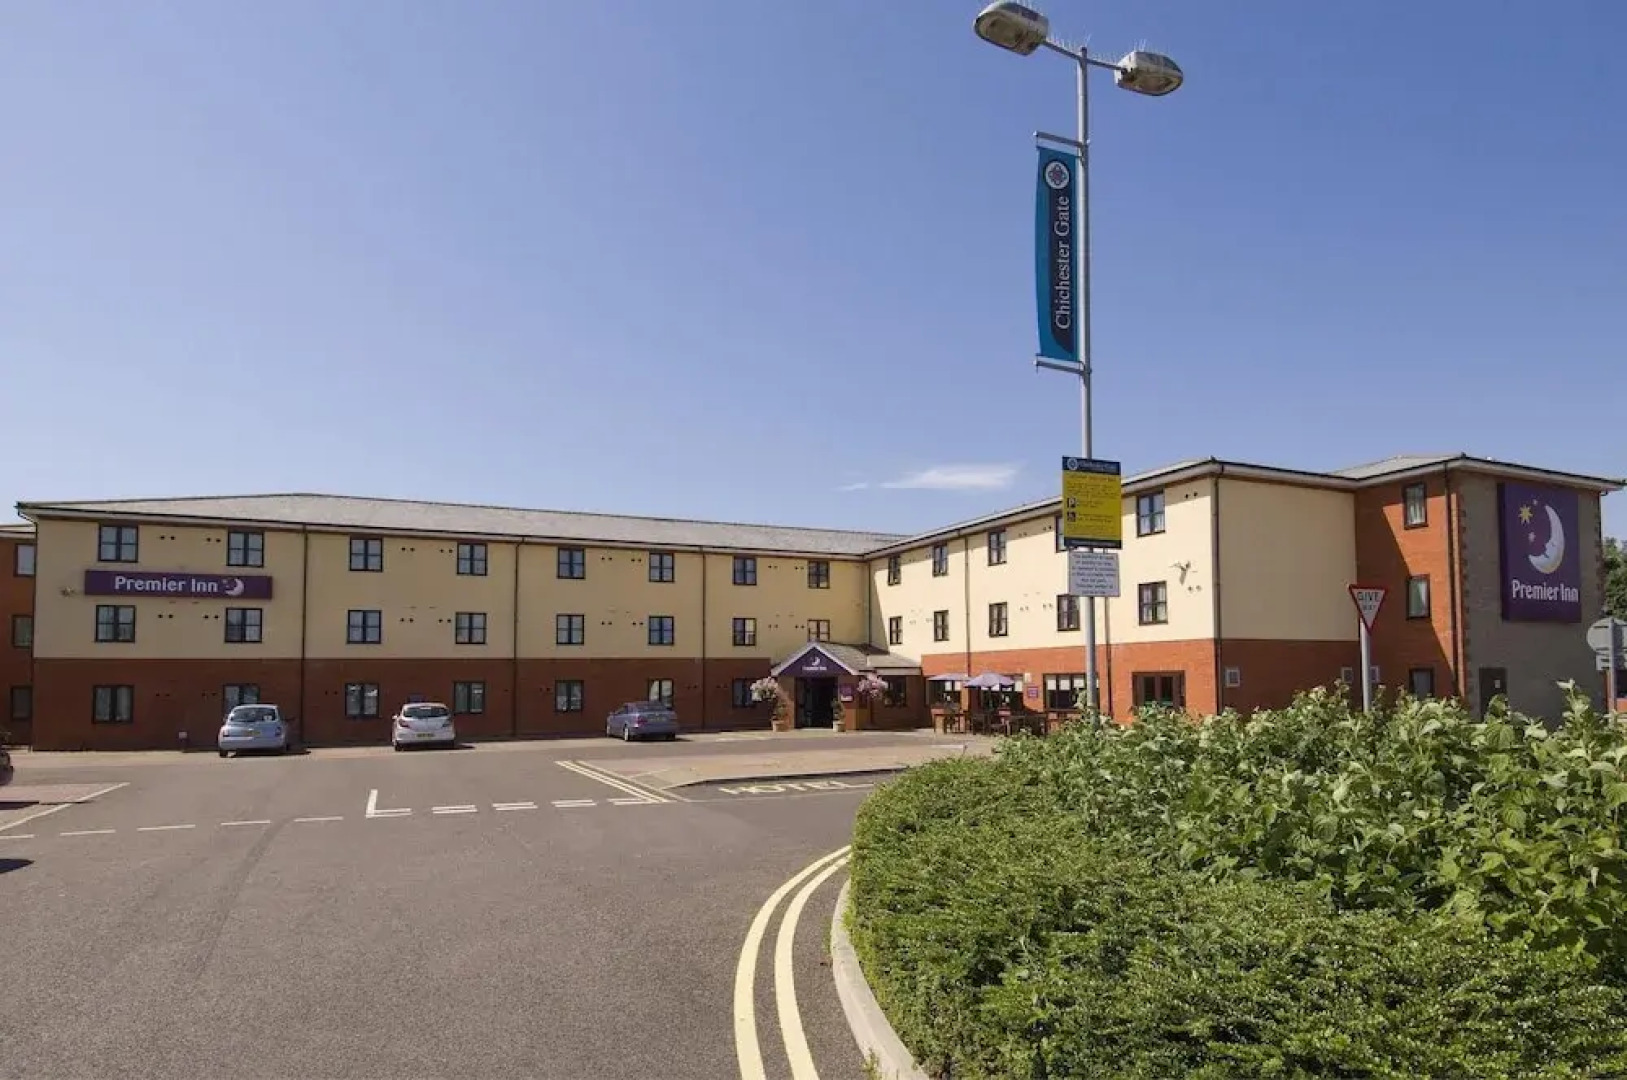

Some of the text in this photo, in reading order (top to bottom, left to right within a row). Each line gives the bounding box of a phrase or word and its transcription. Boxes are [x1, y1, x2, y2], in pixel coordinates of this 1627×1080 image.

[1053, 196, 1070, 330] Chichester Gate
[114, 575, 219, 593] Premier Inn
[1512, 579, 1579, 603] Premier Inn
[1357, 592, 1380, 602] GIVE
[718, 781, 874, 795] HOTEL
